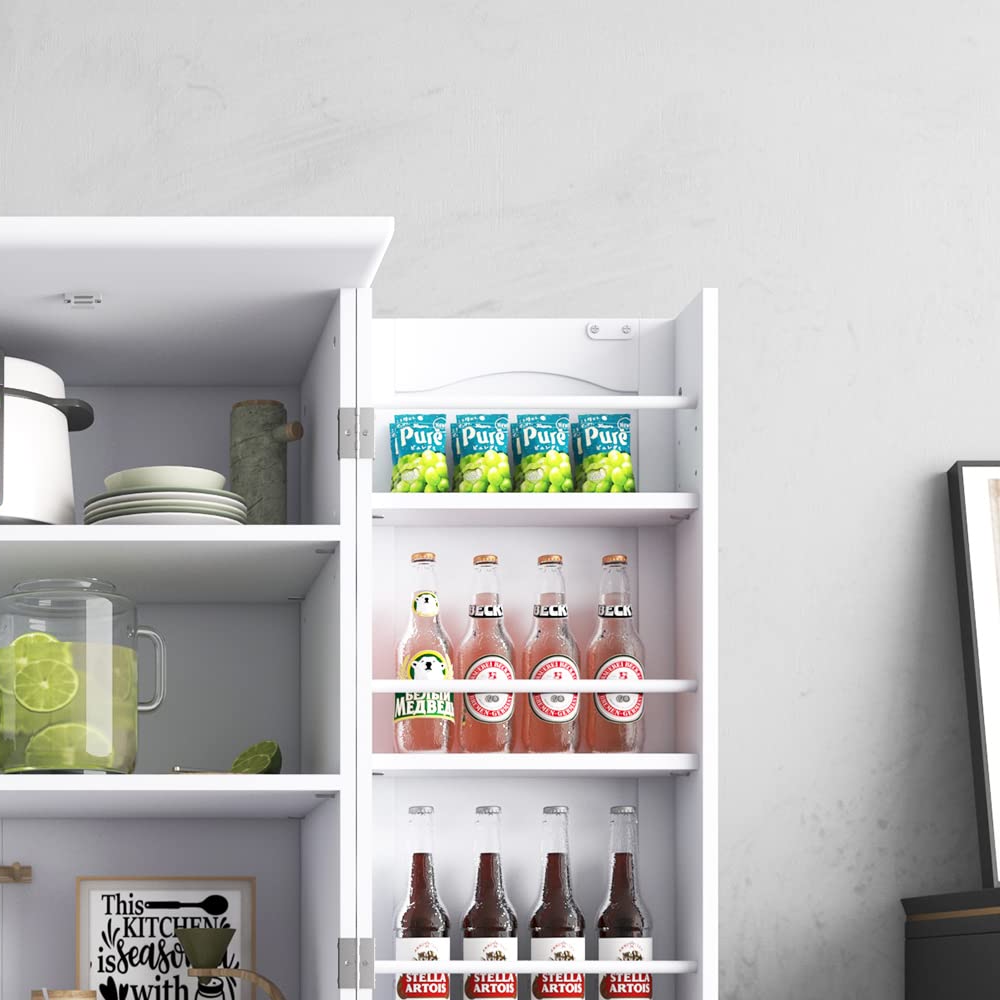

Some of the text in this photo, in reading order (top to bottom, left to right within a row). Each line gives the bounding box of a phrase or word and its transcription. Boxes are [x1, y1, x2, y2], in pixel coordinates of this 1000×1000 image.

[102, 893, 144, 915] This
[123, 917, 219, 938] KITCHEN
[97, 946, 117, 973] is
[405, 973, 446, 982] STELLA
[474, 973, 514, 982] STELLA
[542, 973, 582, 982] STELLA
[610, 973, 650, 982] STELLA
[405, 984, 446, 993] ARTOIS
[474, 984, 514, 993] ARTOIS
[542, 984, 582, 993] ARTOIS
[610, 984, 650, 993] ARTOIS
